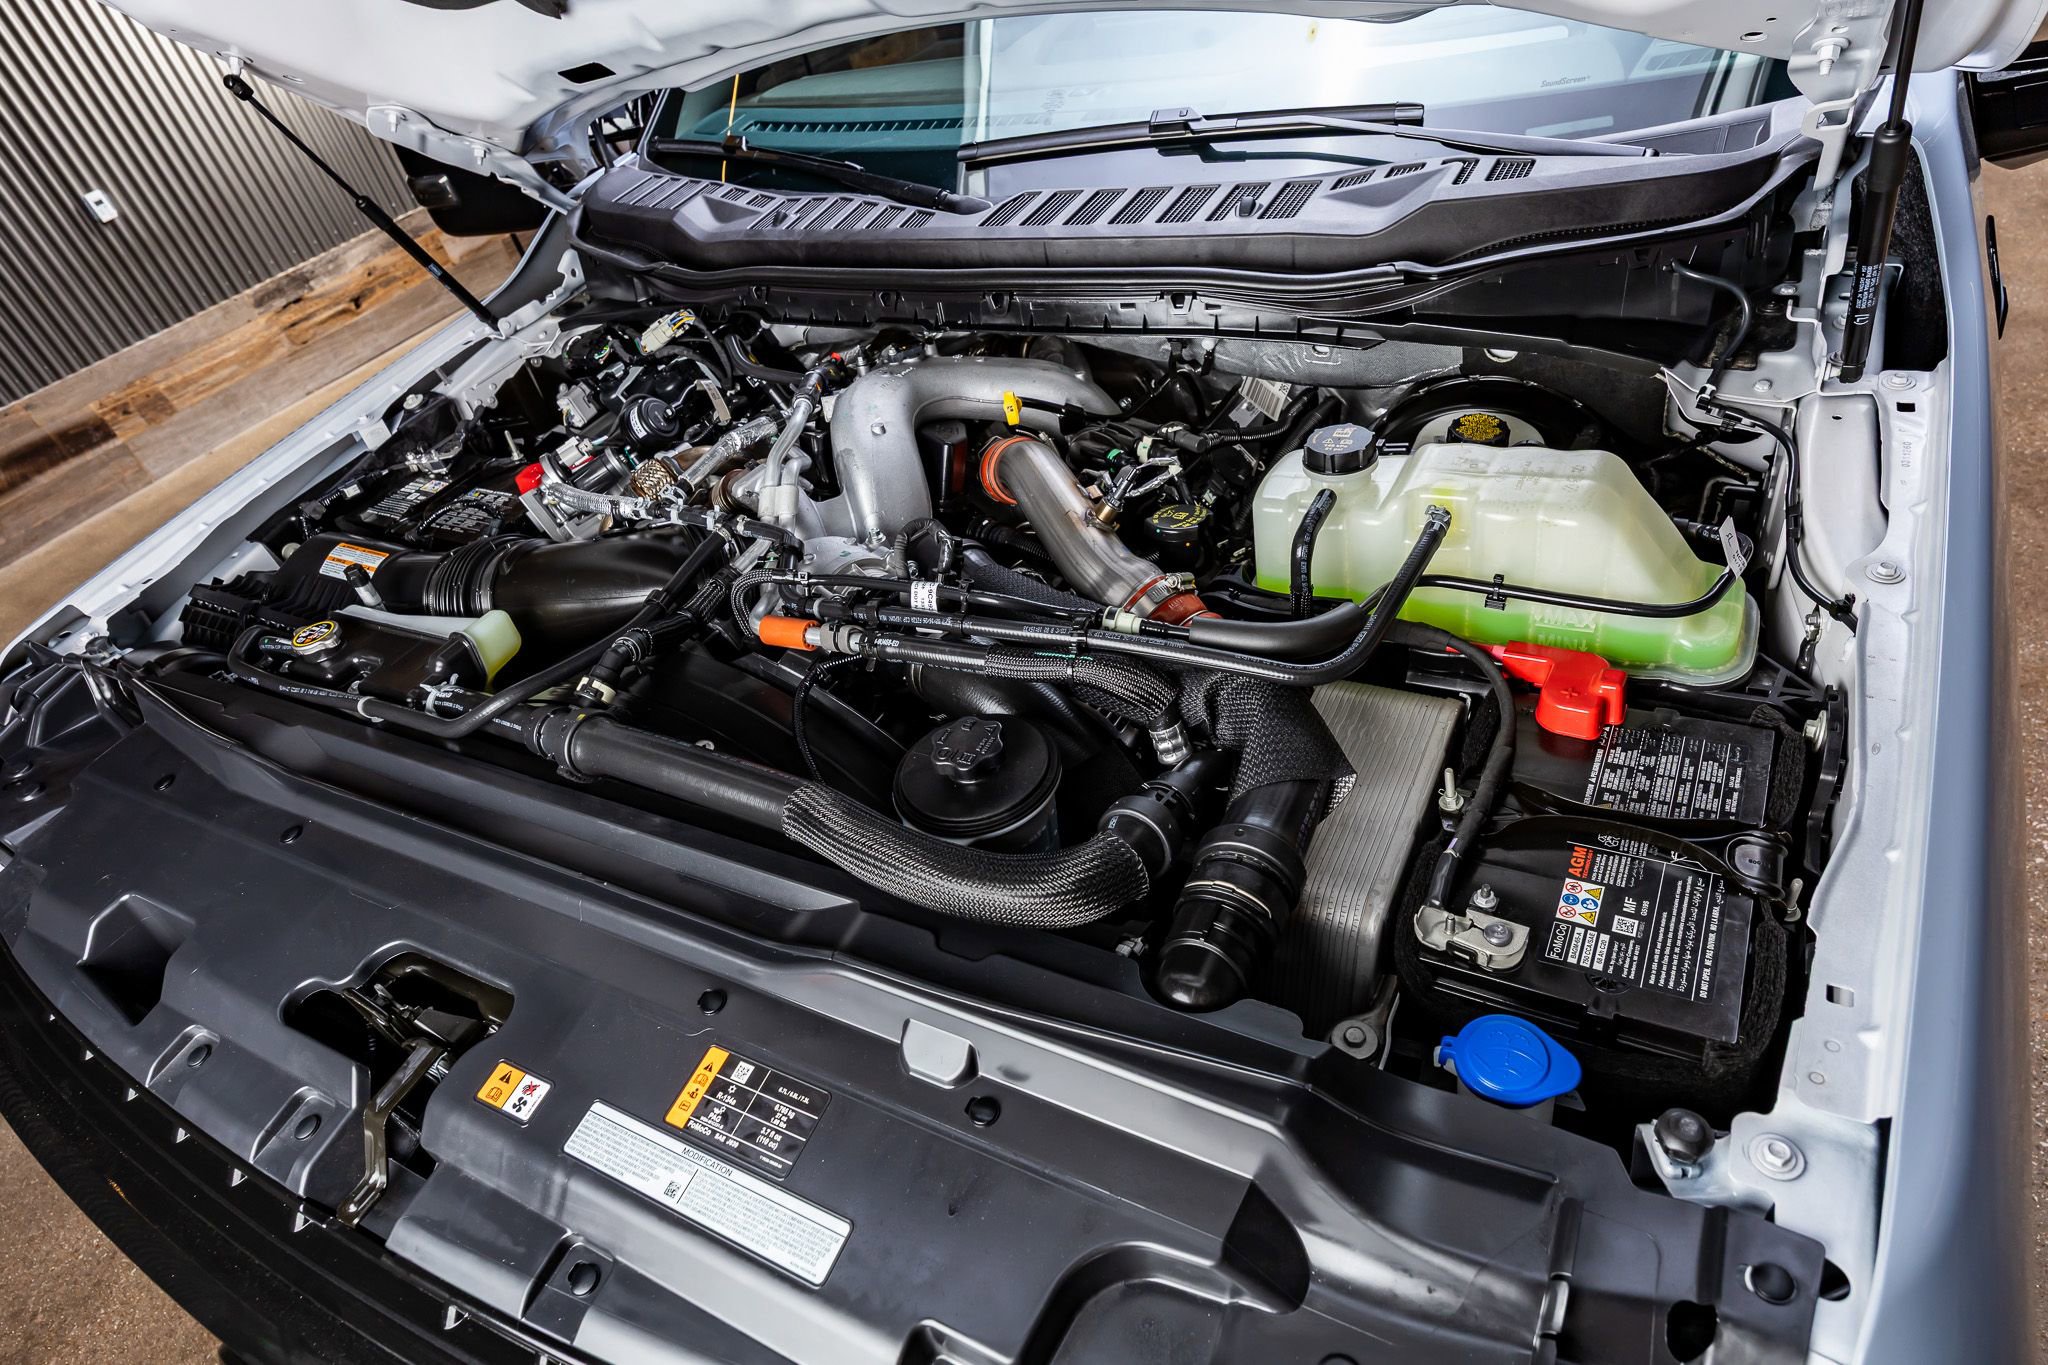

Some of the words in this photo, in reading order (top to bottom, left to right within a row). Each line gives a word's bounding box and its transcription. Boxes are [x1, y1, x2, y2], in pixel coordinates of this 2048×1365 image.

[1568, 846, 1588, 877] AGM
[1582, 849, 1594, 878] TECHNOLOGY
[1622, 896, 1637, 913] MF
[1550, 924, 1570, 959] FoMoCo
[1570, 931, 1582, 960] BAGM-65-A
[1584, 932, 1595, 956] CCA/SAE
[1599, 939, 1608, 950] C20
[1707, 932, 1716, 950] OUVRIR.
[1582, 953, 1591, 966] 750
[1597, 950, 1605, 958] Ah
[1705, 950, 1714, 959] PAS
[1702, 967, 1711, 981] OPEN.
[1699, 990, 1708, 998] DO
[1700, 981, 1709, 991] NOT
[715, 1091, 738, 1106] R-134a
[707, 1111, 722, 1123] PAG
[686, 1119, 713, 1137] FoMoCo
[682, 1147, 733, 1178] MODIFICATION
